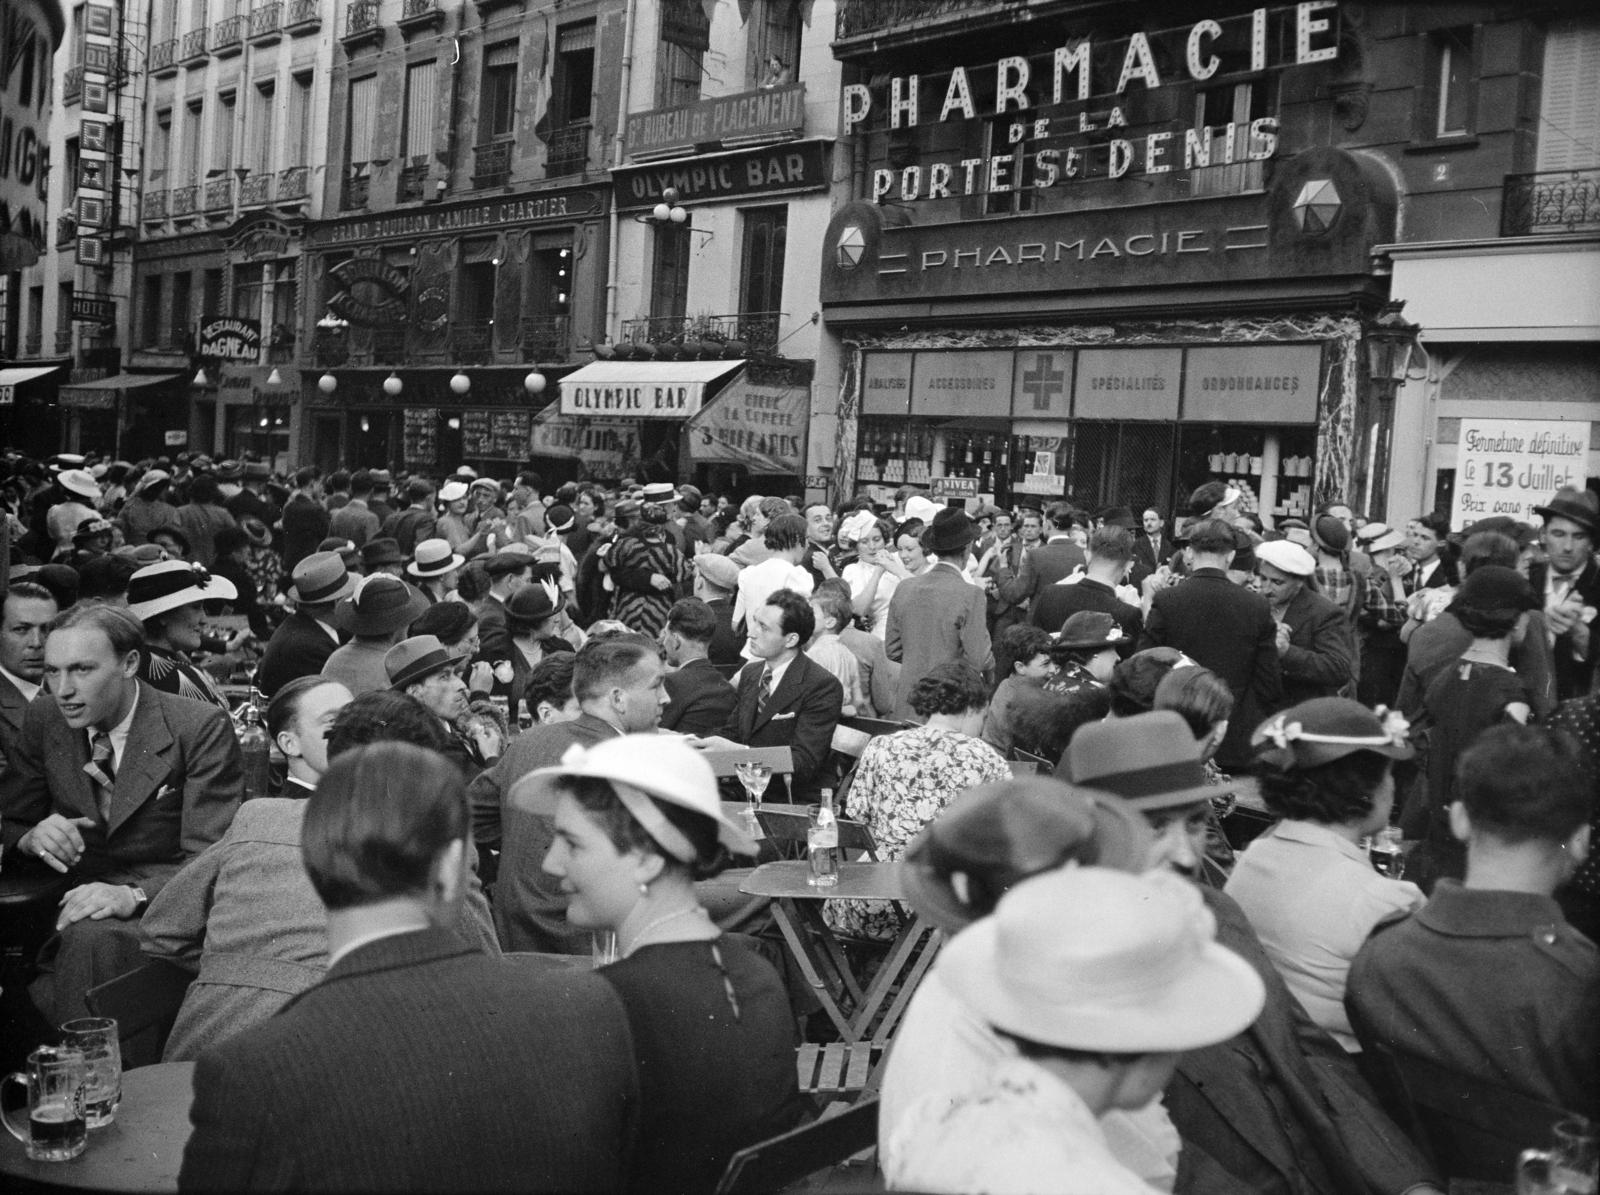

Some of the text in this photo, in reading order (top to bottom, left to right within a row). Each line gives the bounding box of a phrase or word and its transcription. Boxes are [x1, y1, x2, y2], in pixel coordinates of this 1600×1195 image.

[844, 1, 1339, 135] PHARMACIE
[644, 109, 688, 145] BUREAU
[692, 112, 706, 137] DE
[713, 91, 802, 134] PLACEMENT
[1009, 106, 1129, 144] DE LA
[873, 117, 1281, 204] PORTE St DENIS
[1437, 164, 1447, 181] 2
[632, 153, 804, 199] OLYMPIC BAR
[437, 206, 490, 230] CAMILLE
[500, 196, 567, 223] CHARTIER
[921, 231, 1210, 271] PHARMACIE
[202, 319, 259, 342] RESTAURANT
[201, 336, 258, 360] DAGNEAU
[574, 387, 687, 409] OLYMPIC BAR
[1466, 429, 1584, 459] Fermeture définitive
[943, 479, 975, 490] NIVEA
[1485, 462, 1514, 488] 13
[1518, 463, 1573, 491] Juillet
[1461, 493, 1487, 513] Prix
[1492, 501, 1521, 514] sans
